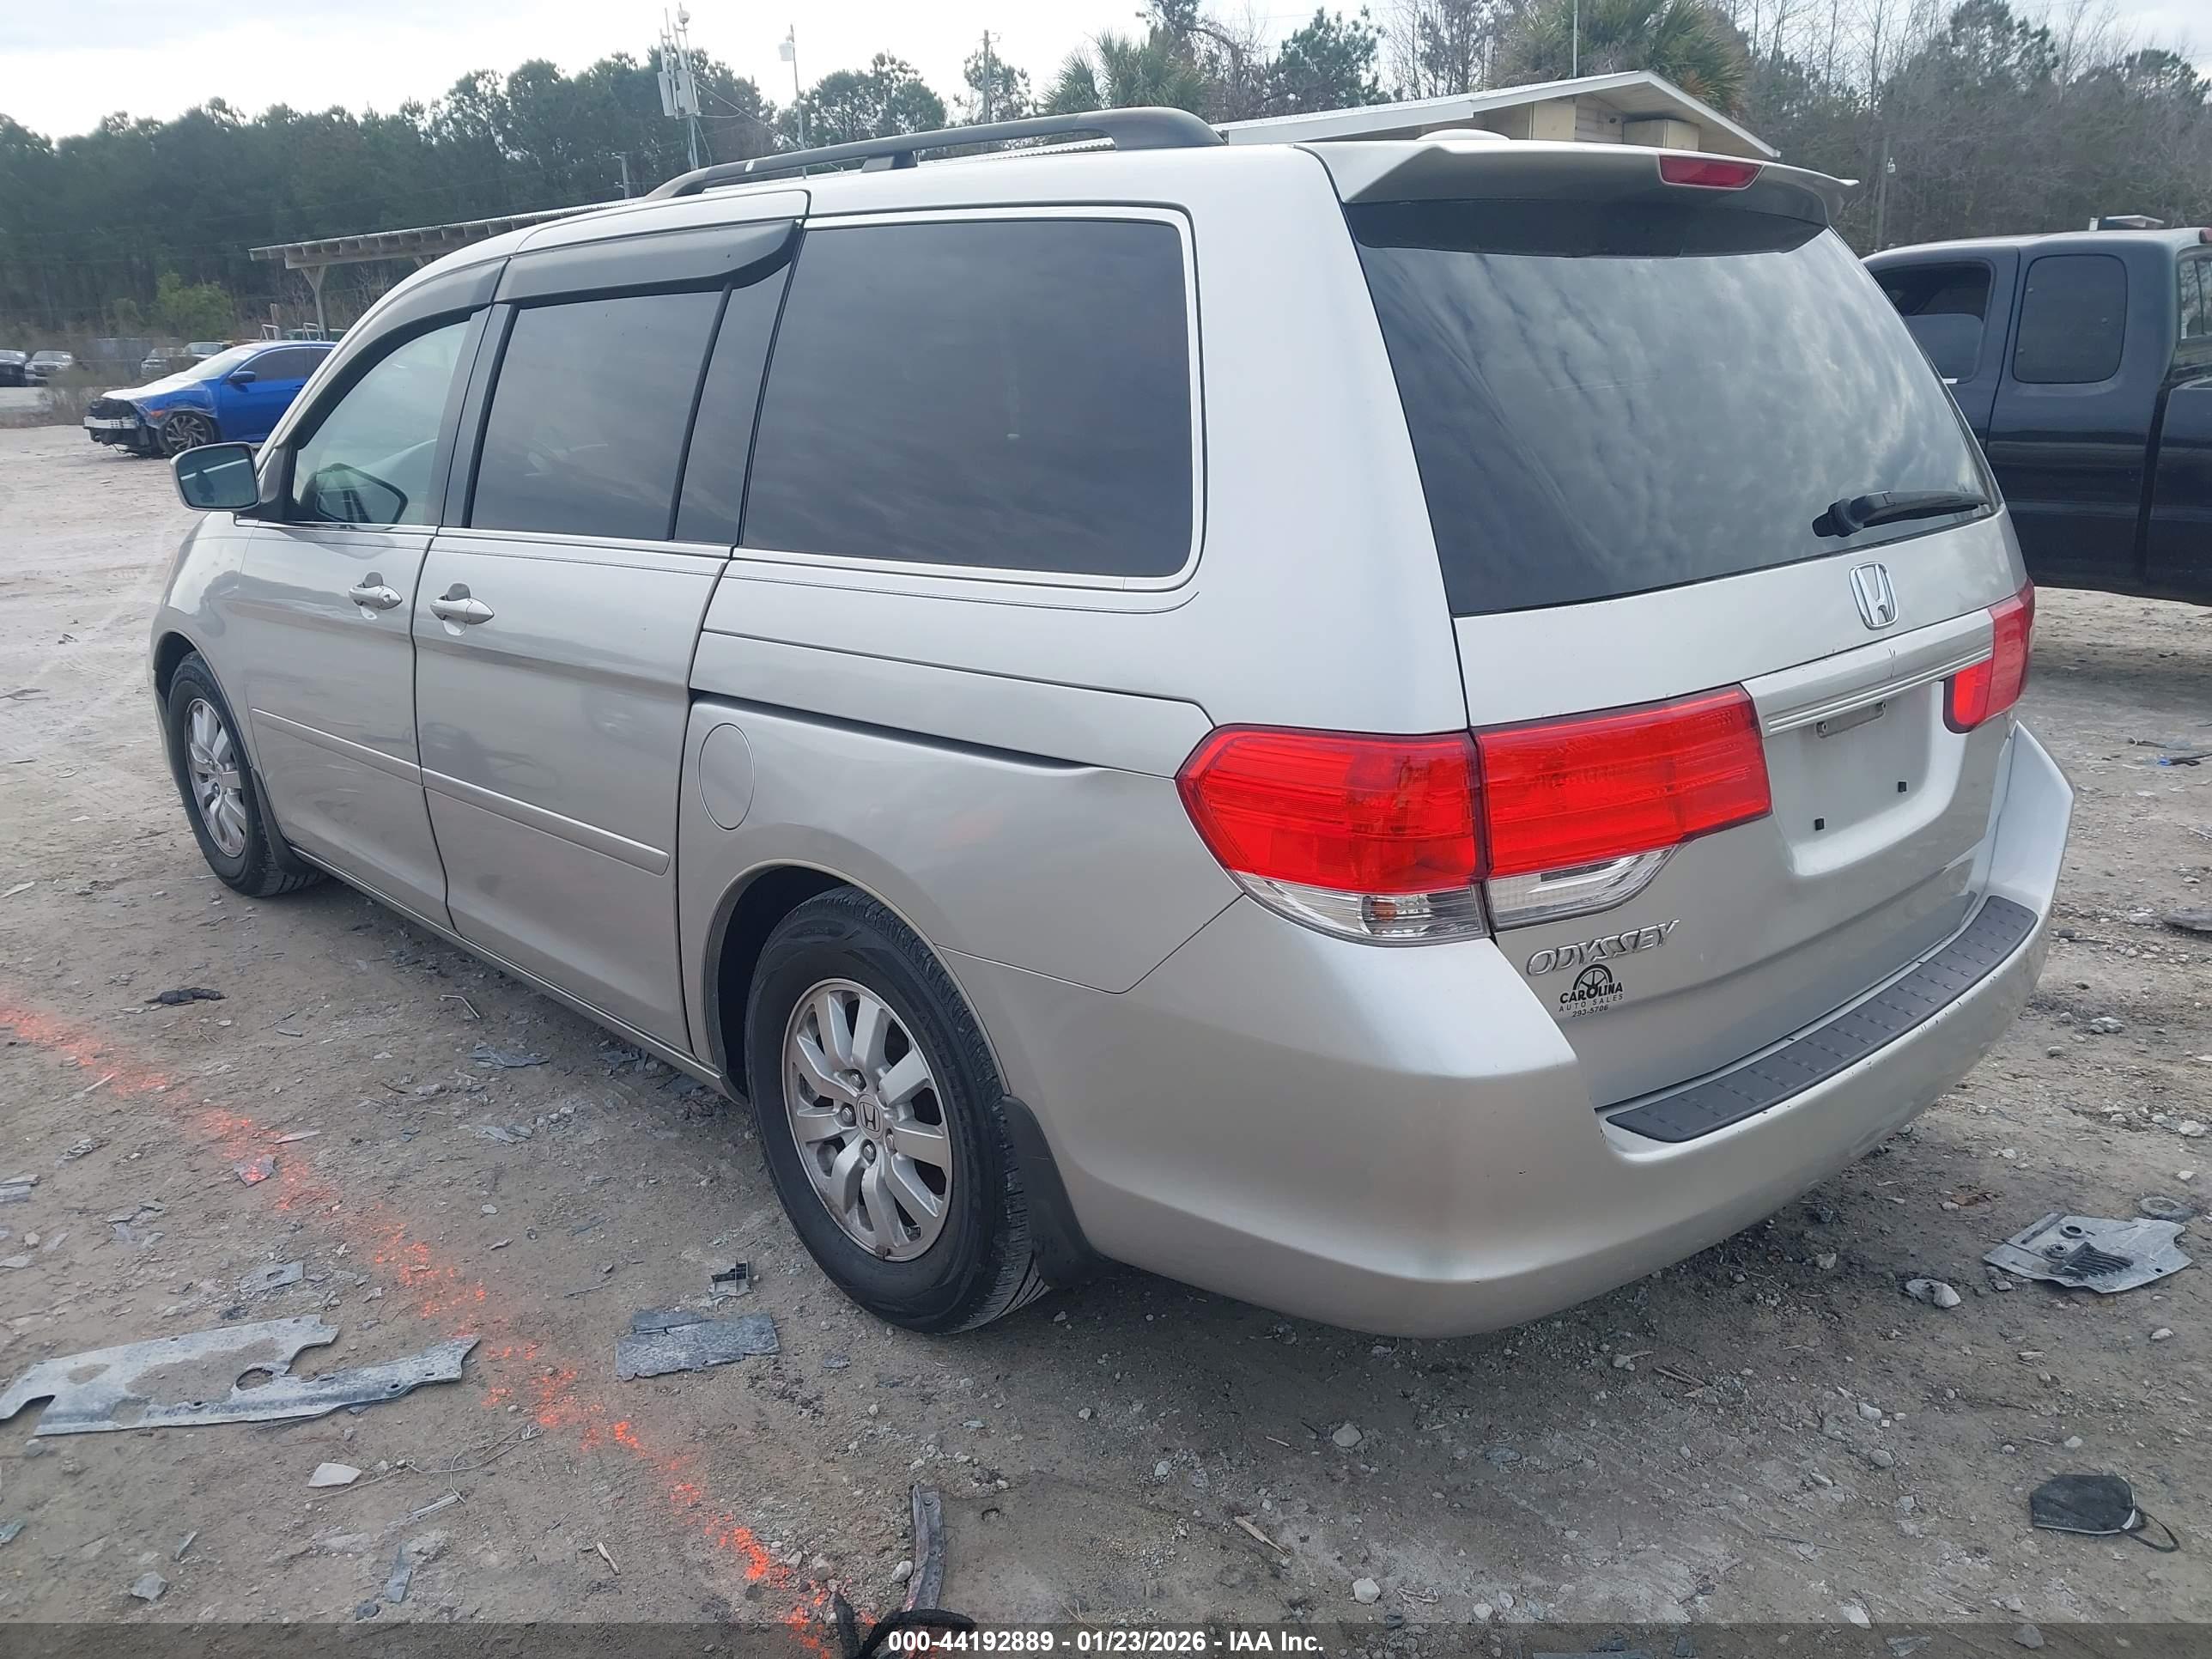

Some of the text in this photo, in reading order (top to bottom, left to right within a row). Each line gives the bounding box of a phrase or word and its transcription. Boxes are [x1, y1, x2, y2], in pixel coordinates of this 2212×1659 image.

[1527, 919, 1680, 975] ODYSSEY
[1559, 981, 1624, 1005] CAROLINA
[1559, 994, 1624, 1012] AUTO SALES
[1572, 1005, 1609, 1018] 293-5706
